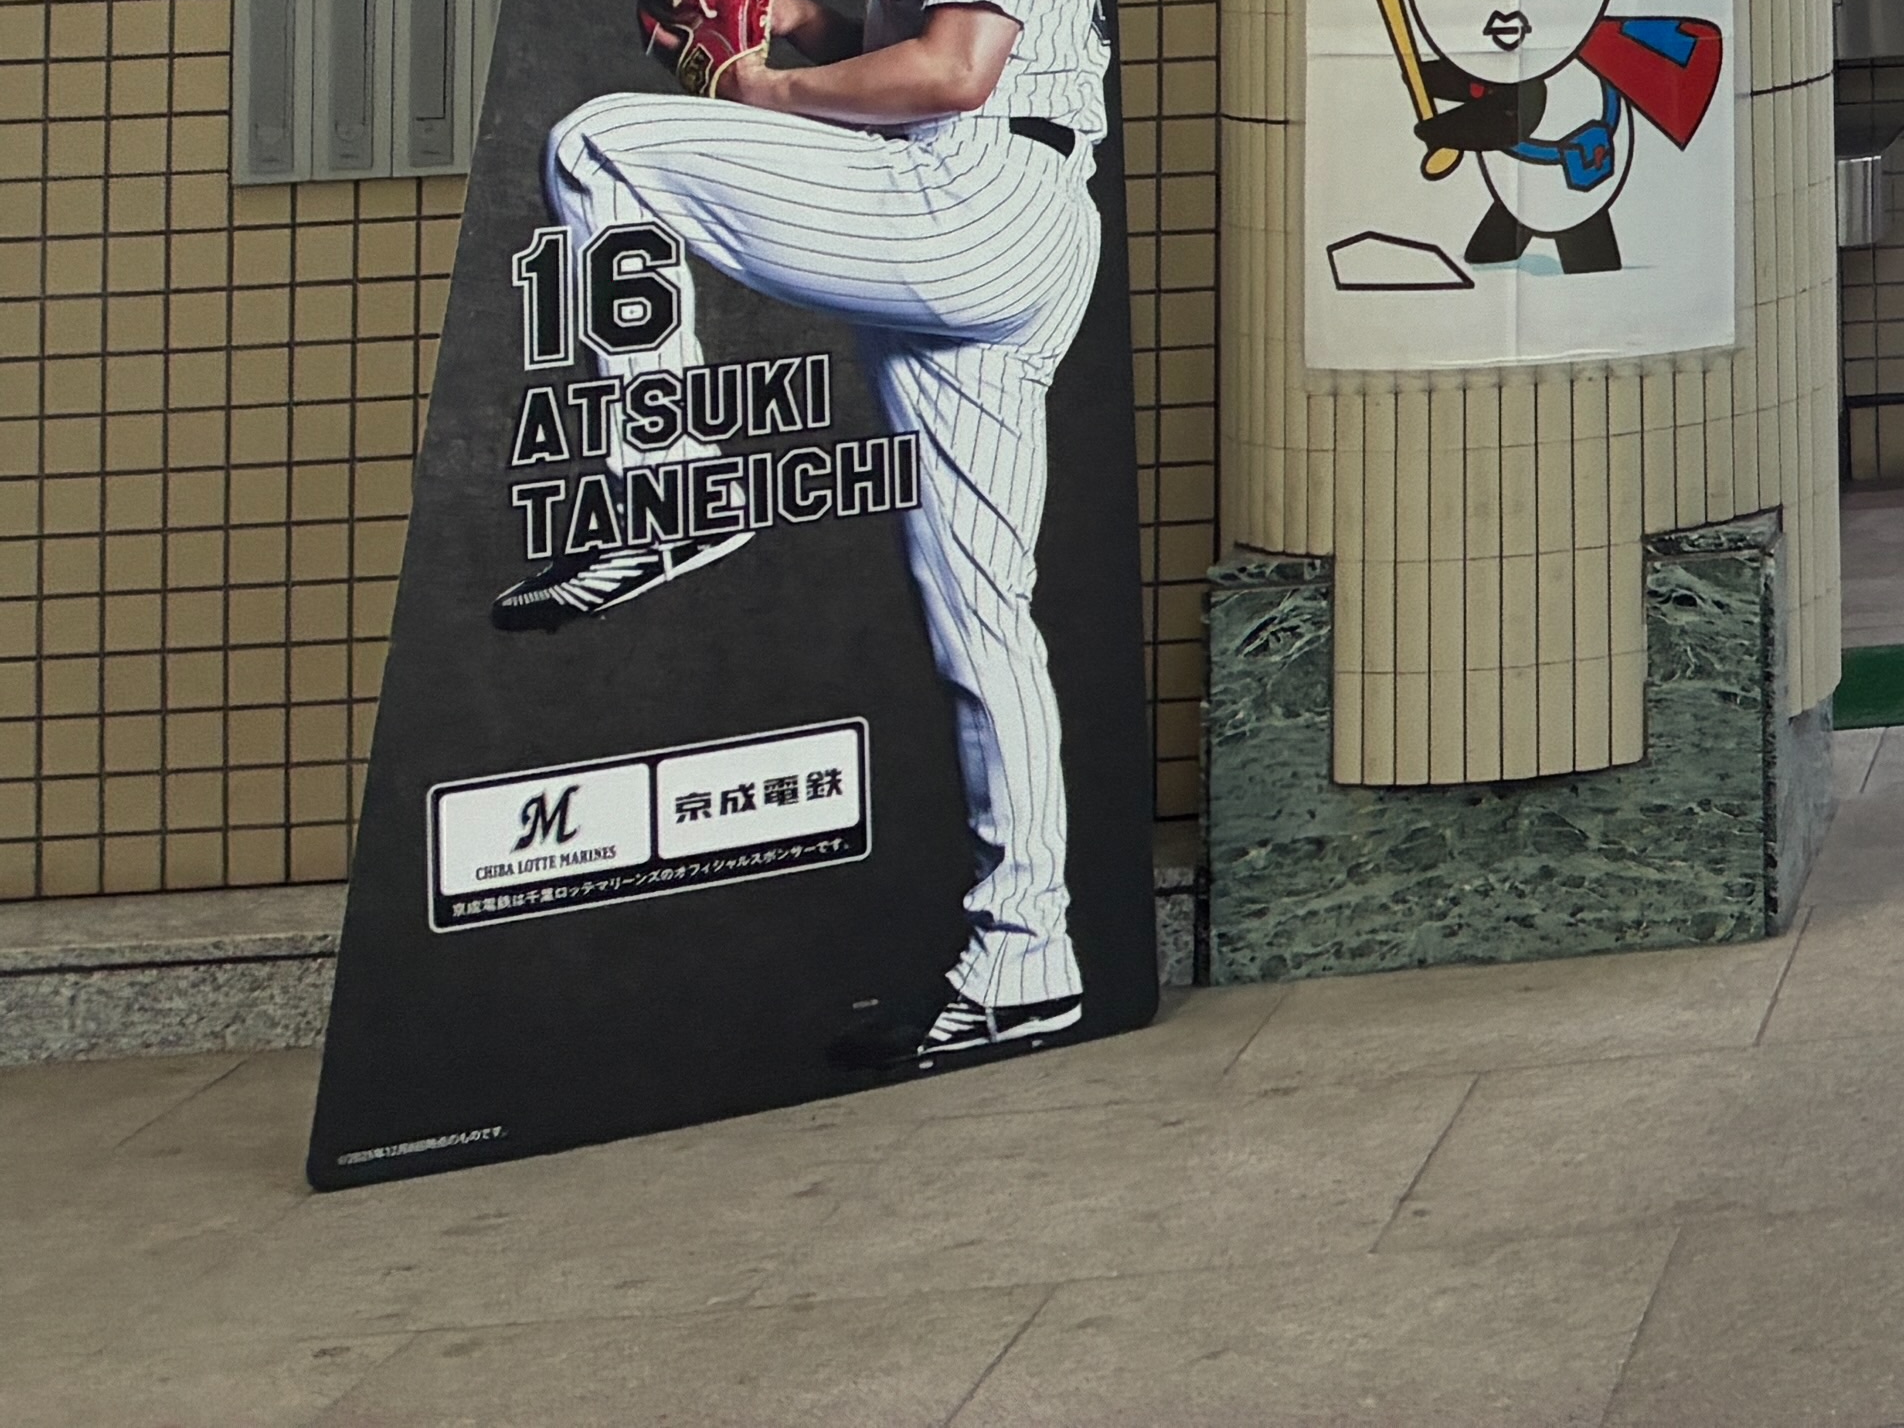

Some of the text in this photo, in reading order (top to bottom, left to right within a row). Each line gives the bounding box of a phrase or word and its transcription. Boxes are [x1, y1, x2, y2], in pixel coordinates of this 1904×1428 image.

[511, 216, 683, 373] 16
[511, 352, 831, 465] ATSUKI
[511, 429, 922, 561] TANEICHI
[674, 766, 845, 825] 京成電鉄
[474, 844, 617, 882] CHIBA LOTTE MARINES
